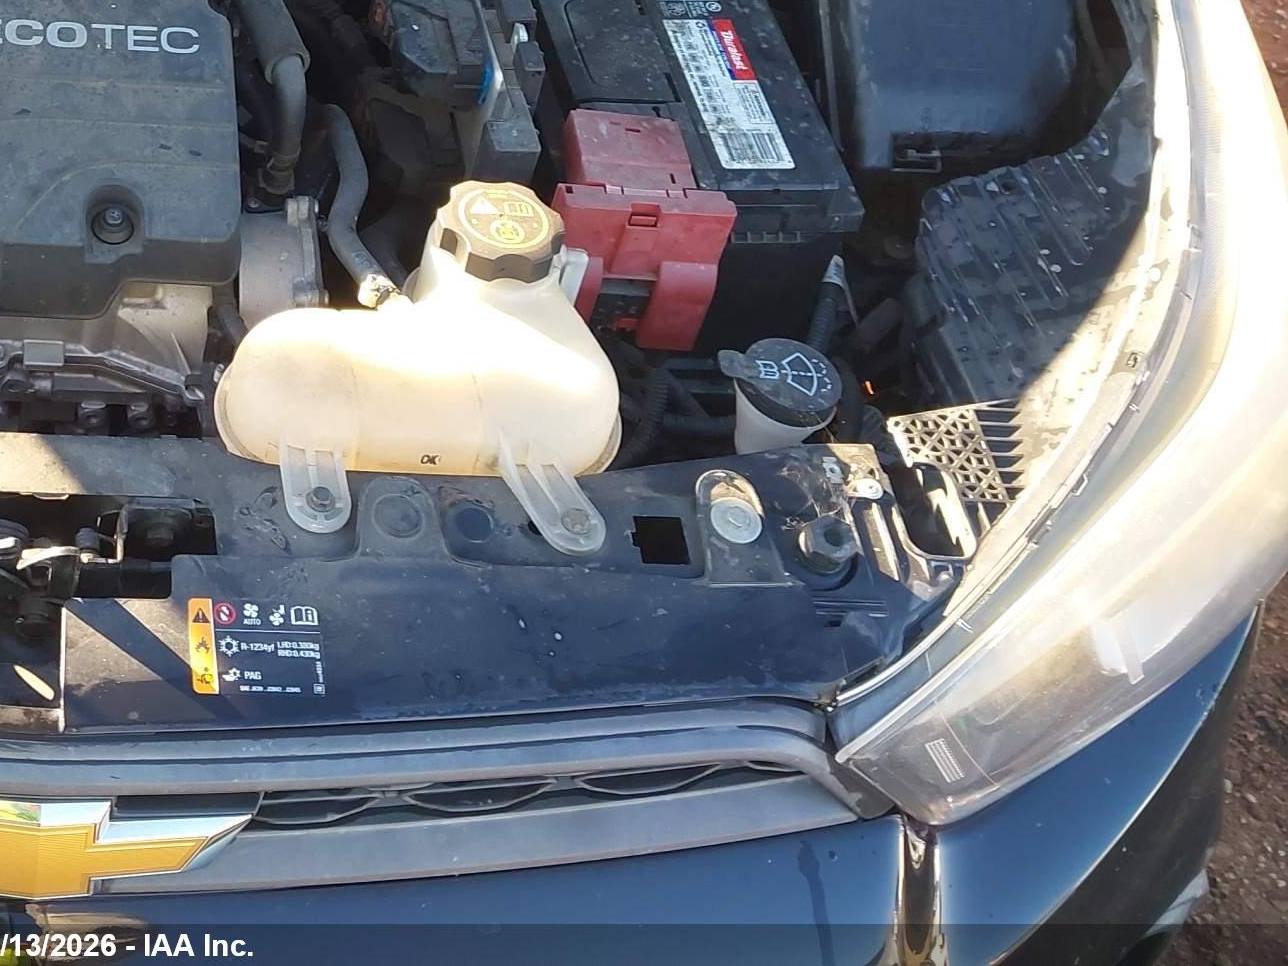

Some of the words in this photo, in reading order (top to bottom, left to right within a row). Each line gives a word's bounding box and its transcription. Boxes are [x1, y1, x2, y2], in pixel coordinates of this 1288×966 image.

[719, 29, 750, 71] Duralast
[243, 618, 262, 626] AUTO
[240, 642, 275, 653] R-1234yf
[244, 671, 262, 680] PAG
